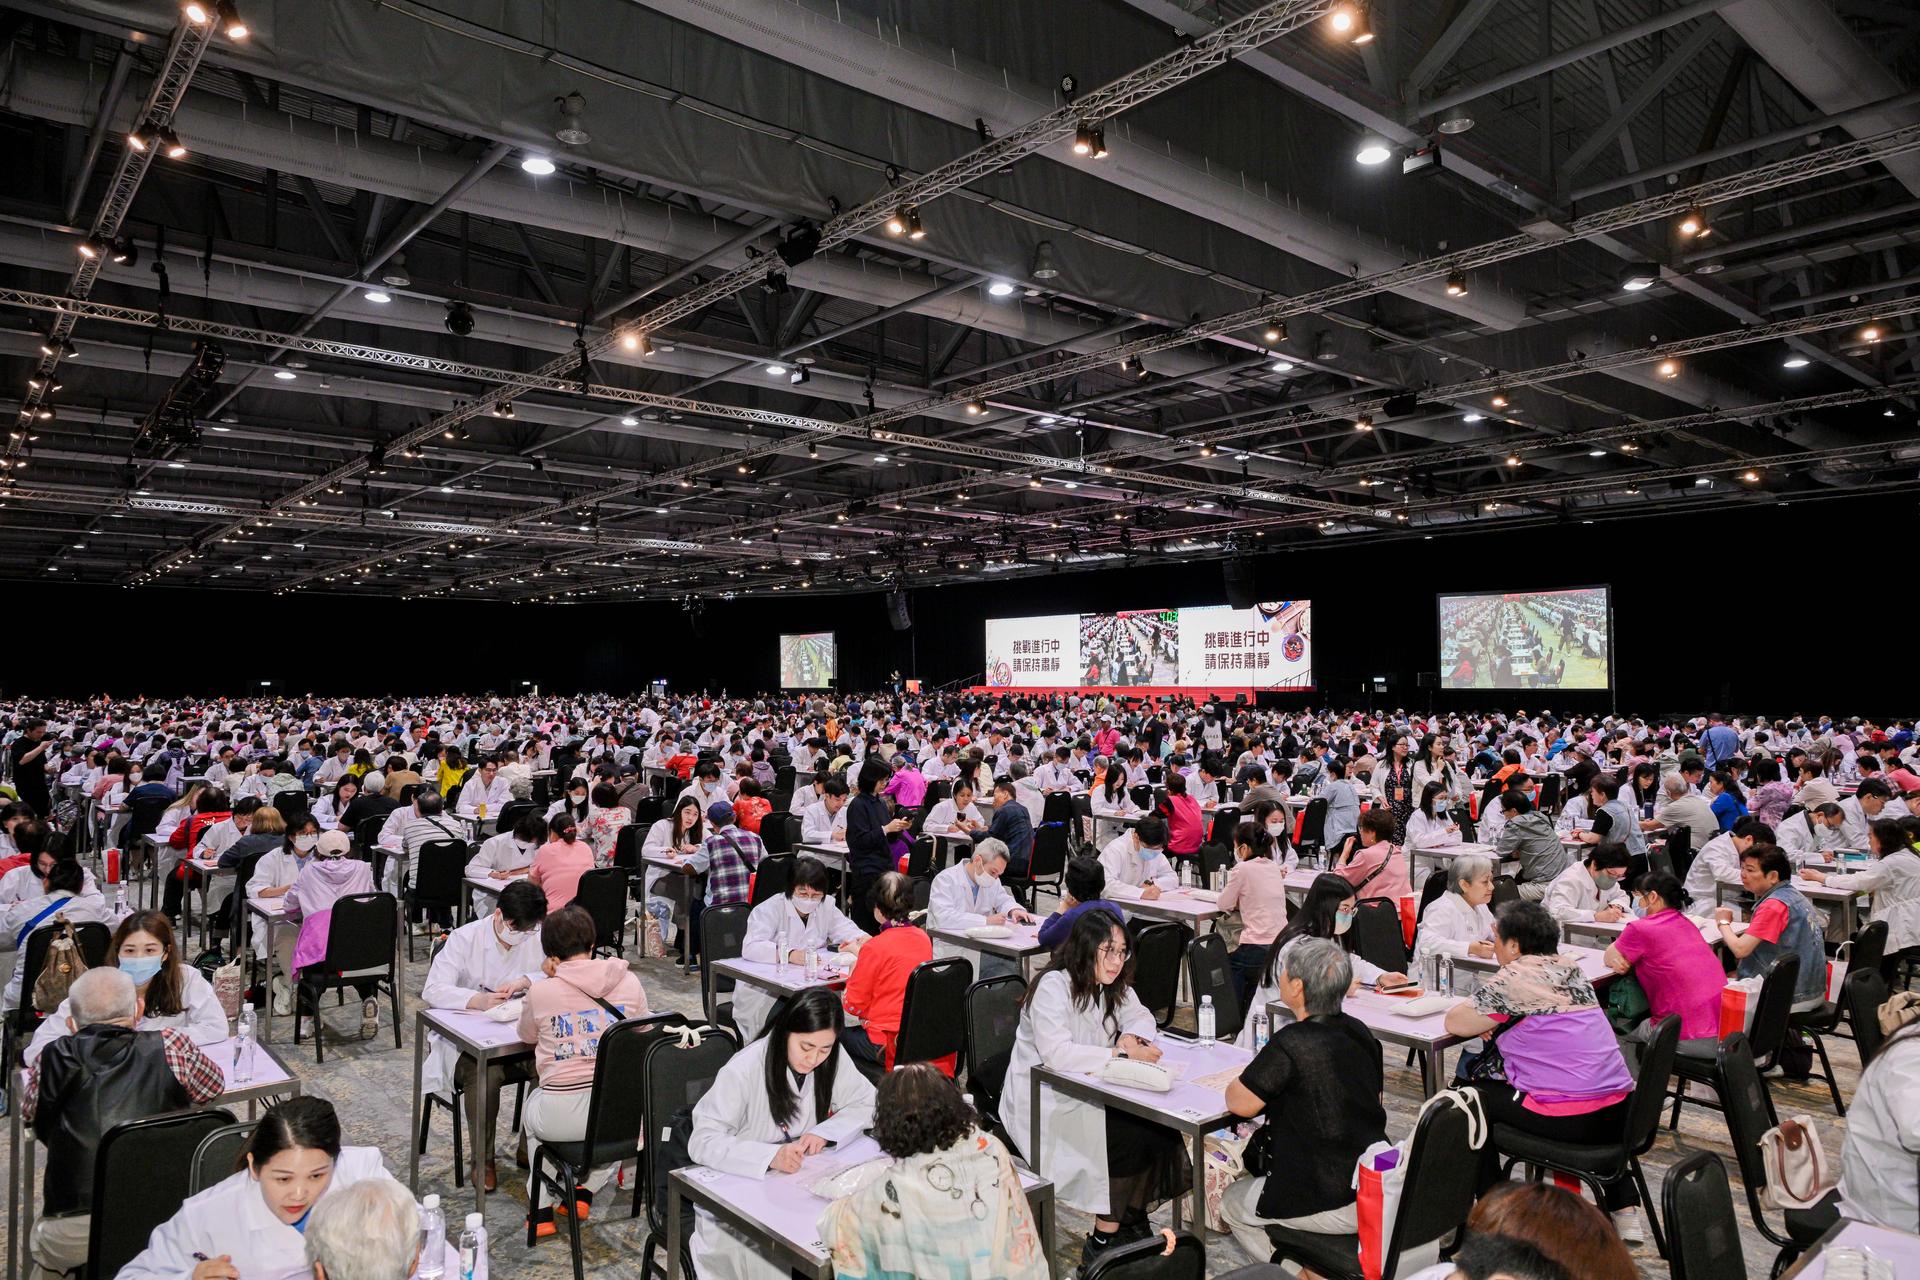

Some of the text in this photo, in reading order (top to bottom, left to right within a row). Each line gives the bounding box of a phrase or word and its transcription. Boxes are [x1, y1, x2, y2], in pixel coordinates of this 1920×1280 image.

[1013, 639, 1060, 654] 挑戰進行中
[1205, 630, 1270, 648] 挑戰進行中
[1013, 657, 1060, 672] 請保持肅靜
[1205, 652, 1270, 669] 請保持肅靜
